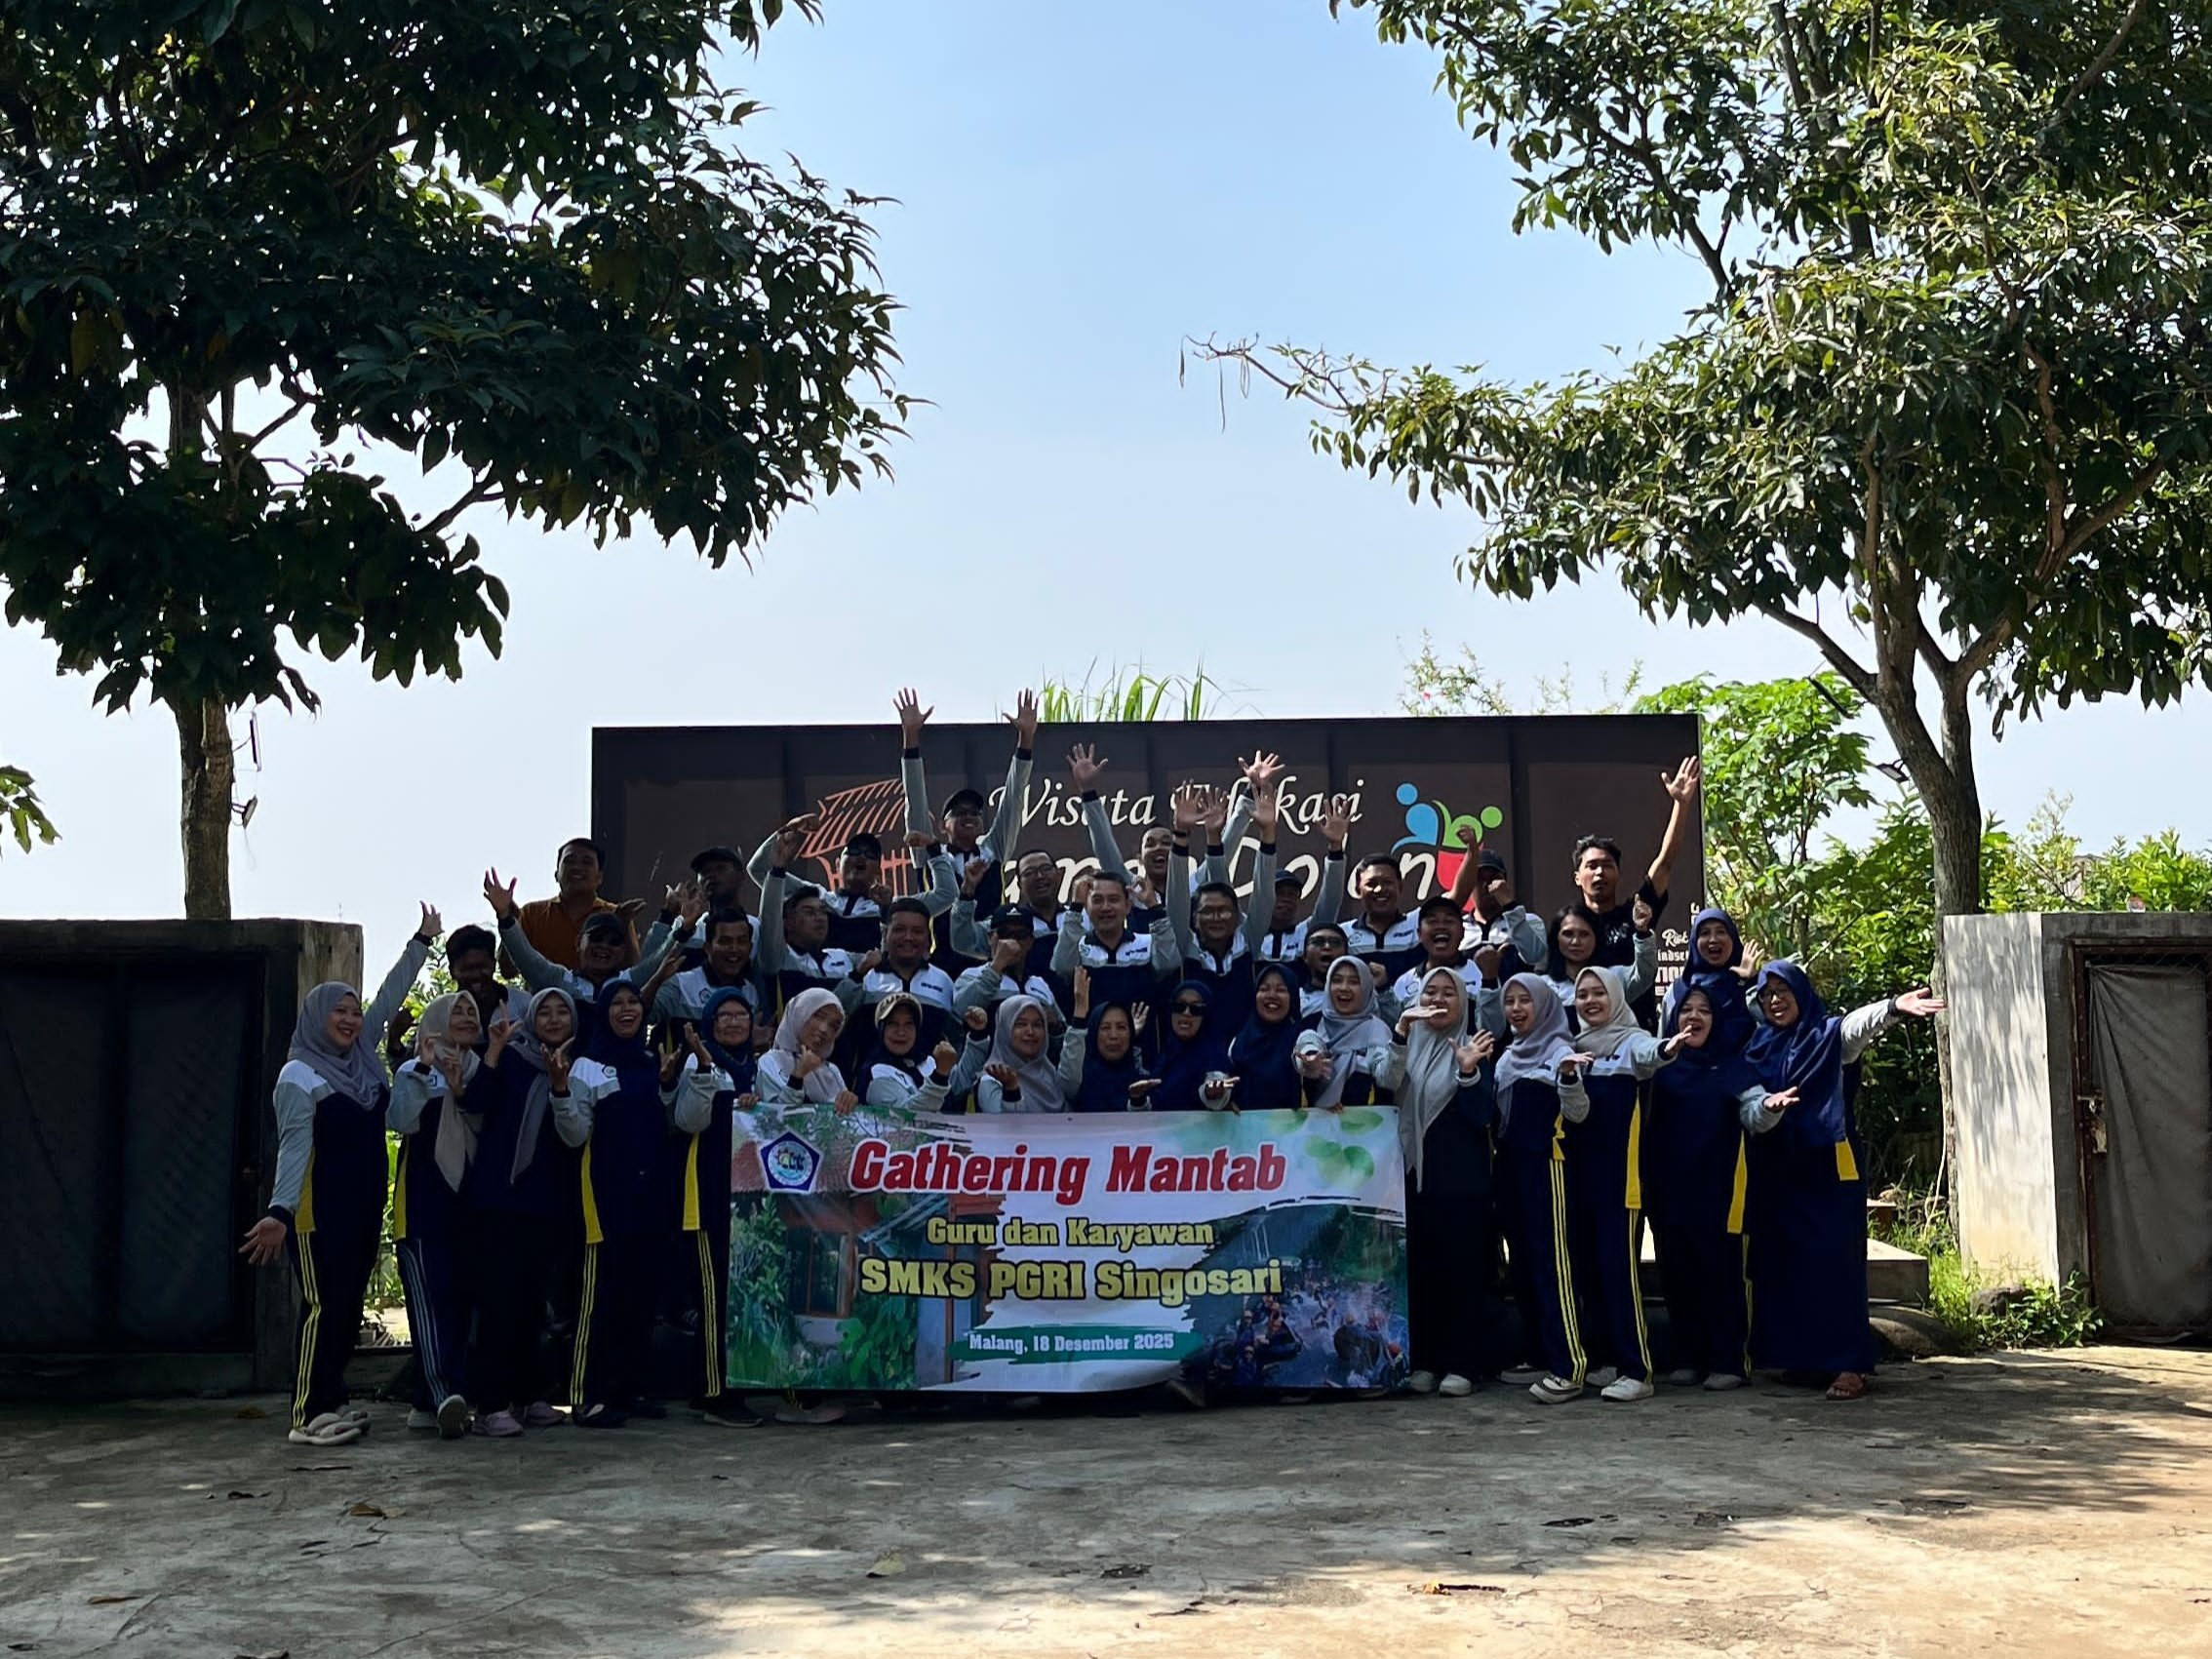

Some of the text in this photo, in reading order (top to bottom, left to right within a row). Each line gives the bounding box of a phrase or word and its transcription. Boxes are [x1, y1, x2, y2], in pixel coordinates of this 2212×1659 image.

[989, 778, 1157, 827] Wista
[849, 1140, 1091, 1205] Gathering
[1105, 1144, 1286, 1193] Mantab
[928, 1217, 1214, 1252] Guru dan Karyawan
[860, 1258, 1283, 1307] SMKS PGRI Singosari
[968, 1333, 1174, 1355] Malang, 18 Desember 2025
